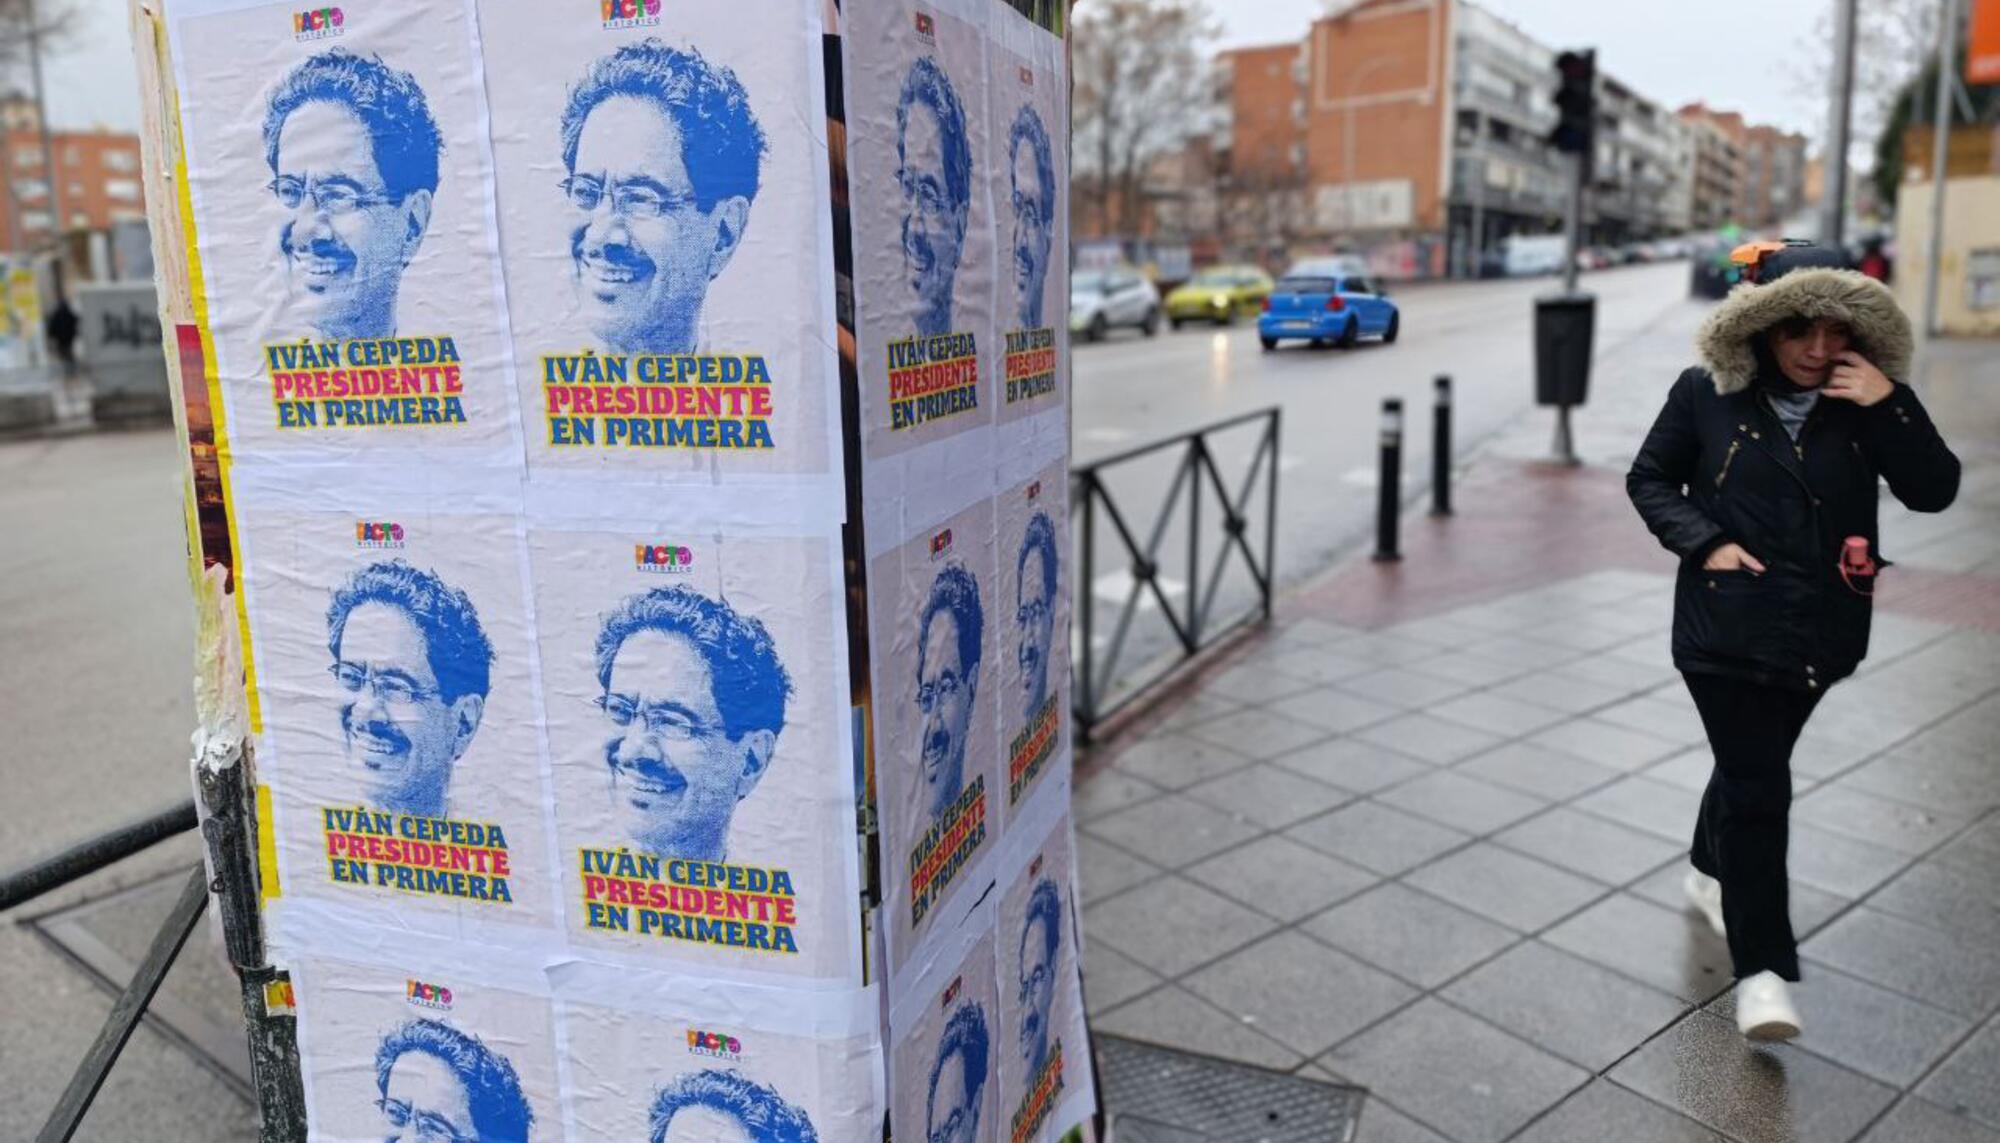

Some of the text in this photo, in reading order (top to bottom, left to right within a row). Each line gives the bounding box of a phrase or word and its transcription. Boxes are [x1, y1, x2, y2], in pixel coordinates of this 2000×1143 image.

[267, 337, 460, 369] IVÁN CEPEDA
[544, 350, 771, 384] IVÁN CEPEDA
[888, 333, 977, 369] IVÁN CEPEDA
[273, 365, 463, 398] PRESIDENTE
[890, 357, 977, 400] PRESIDENTE
[279, 396, 467, 427] EN PRIMERA
[547, 386, 773, 415] PRESIDENTE
[892, 385, 978, 429] EN PRIMERA
[551, 418, 775, 447] EN PRIMERA
[636, 545, 692, 566] PACTO
[324, 807, 507, 849] IVÁN CEPEDA
[912, 794, 986, 902] PRESIDENTE
[327, 832, 510, 875] PRESIDENTE
[582, 848, 795, 896] IVÁN CEPEDA
[332, 859, 512, 902] EN PRIMERA
[912, 820, 986, 930] EN PRIMERA
[584, 875, 796, 924] PRESIDENTE
[588, 903, 799, 952] EN PRIMERA
